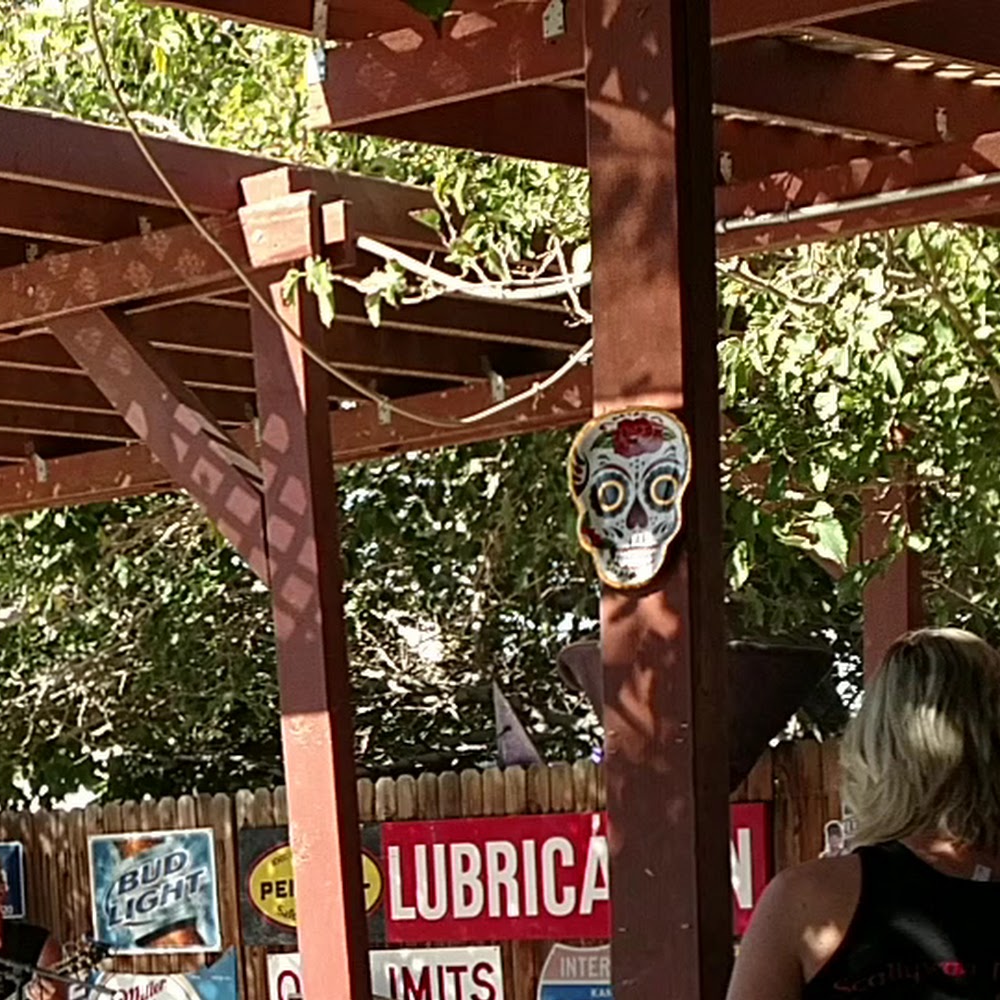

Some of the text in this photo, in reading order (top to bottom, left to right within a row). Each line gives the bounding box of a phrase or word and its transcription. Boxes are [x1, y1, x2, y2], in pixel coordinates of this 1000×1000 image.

[107, 867, 206, 926] LIGHT
[117, 850, 188, 895] BUD
[388, 827, 753, 921] LUBRICAN
[560, 956, 611, 979] INTER
